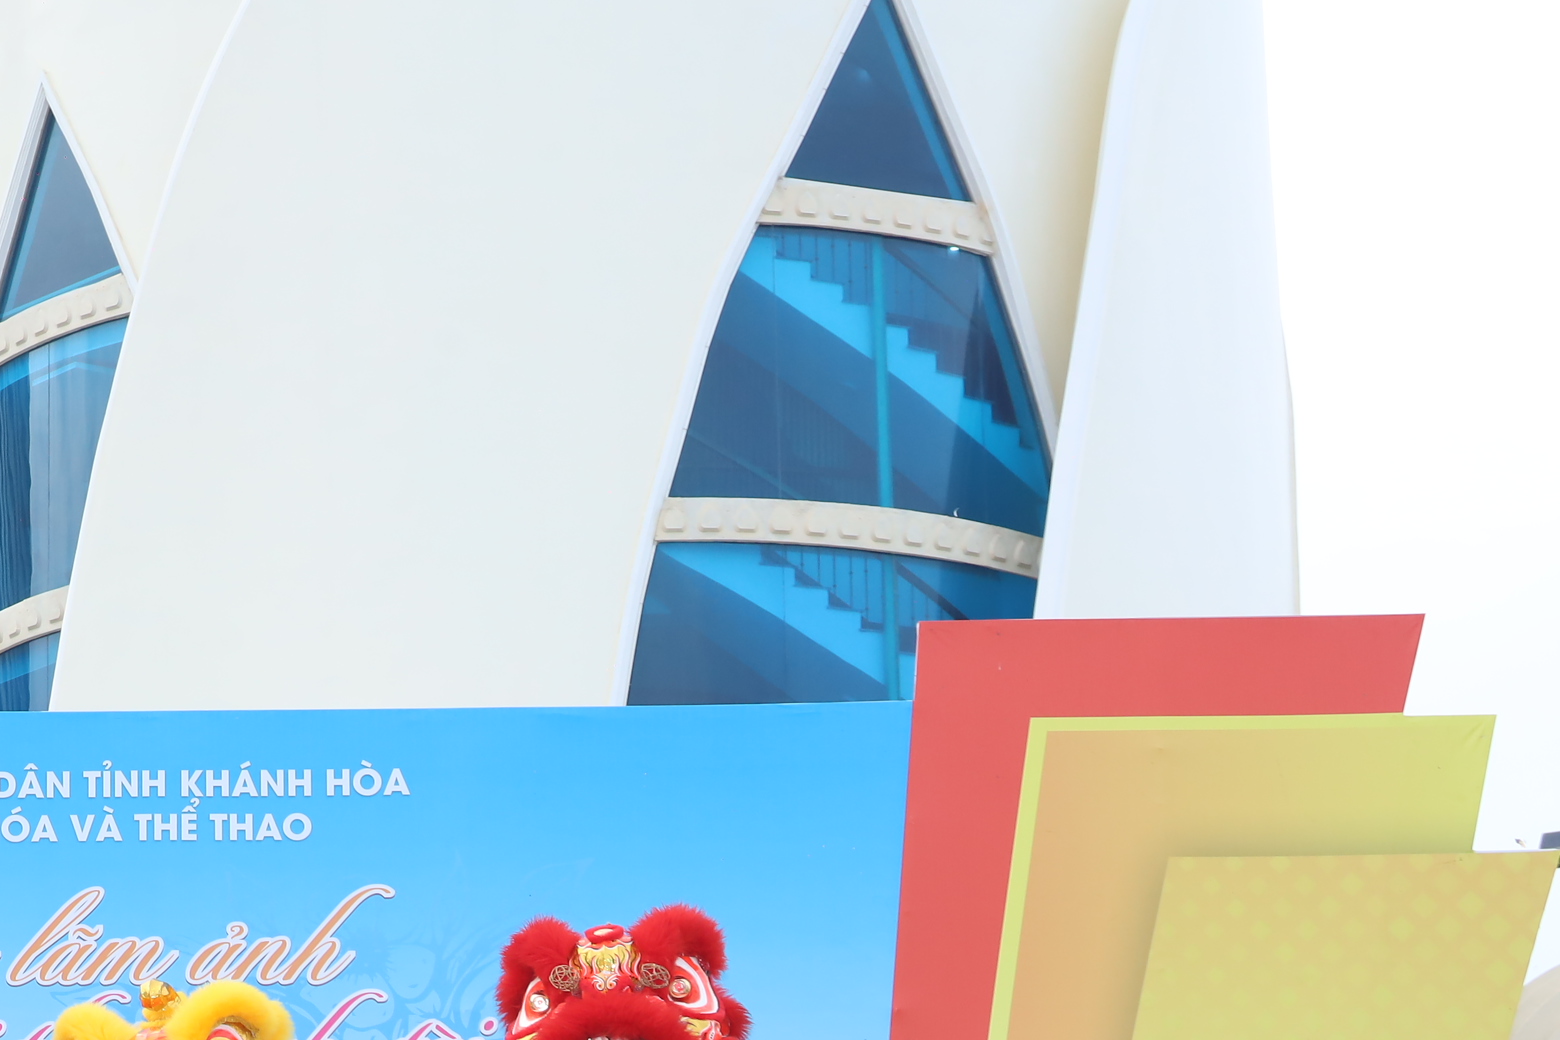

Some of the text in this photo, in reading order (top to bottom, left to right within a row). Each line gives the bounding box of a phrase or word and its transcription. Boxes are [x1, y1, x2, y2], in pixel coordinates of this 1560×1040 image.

[83, 760, 166, 798] TỈNH
[181, 761, 312, 798] KHÁNH
[326, 760, 411, 796] HÒA
[70, 805, 123, 842] VÀ
[134, 797, 200, 841] THỂ
[209, 812, 312, 841] THAO
[9, 888, 178, 983] lãm
[188, 885, 392, 983] ảnh
